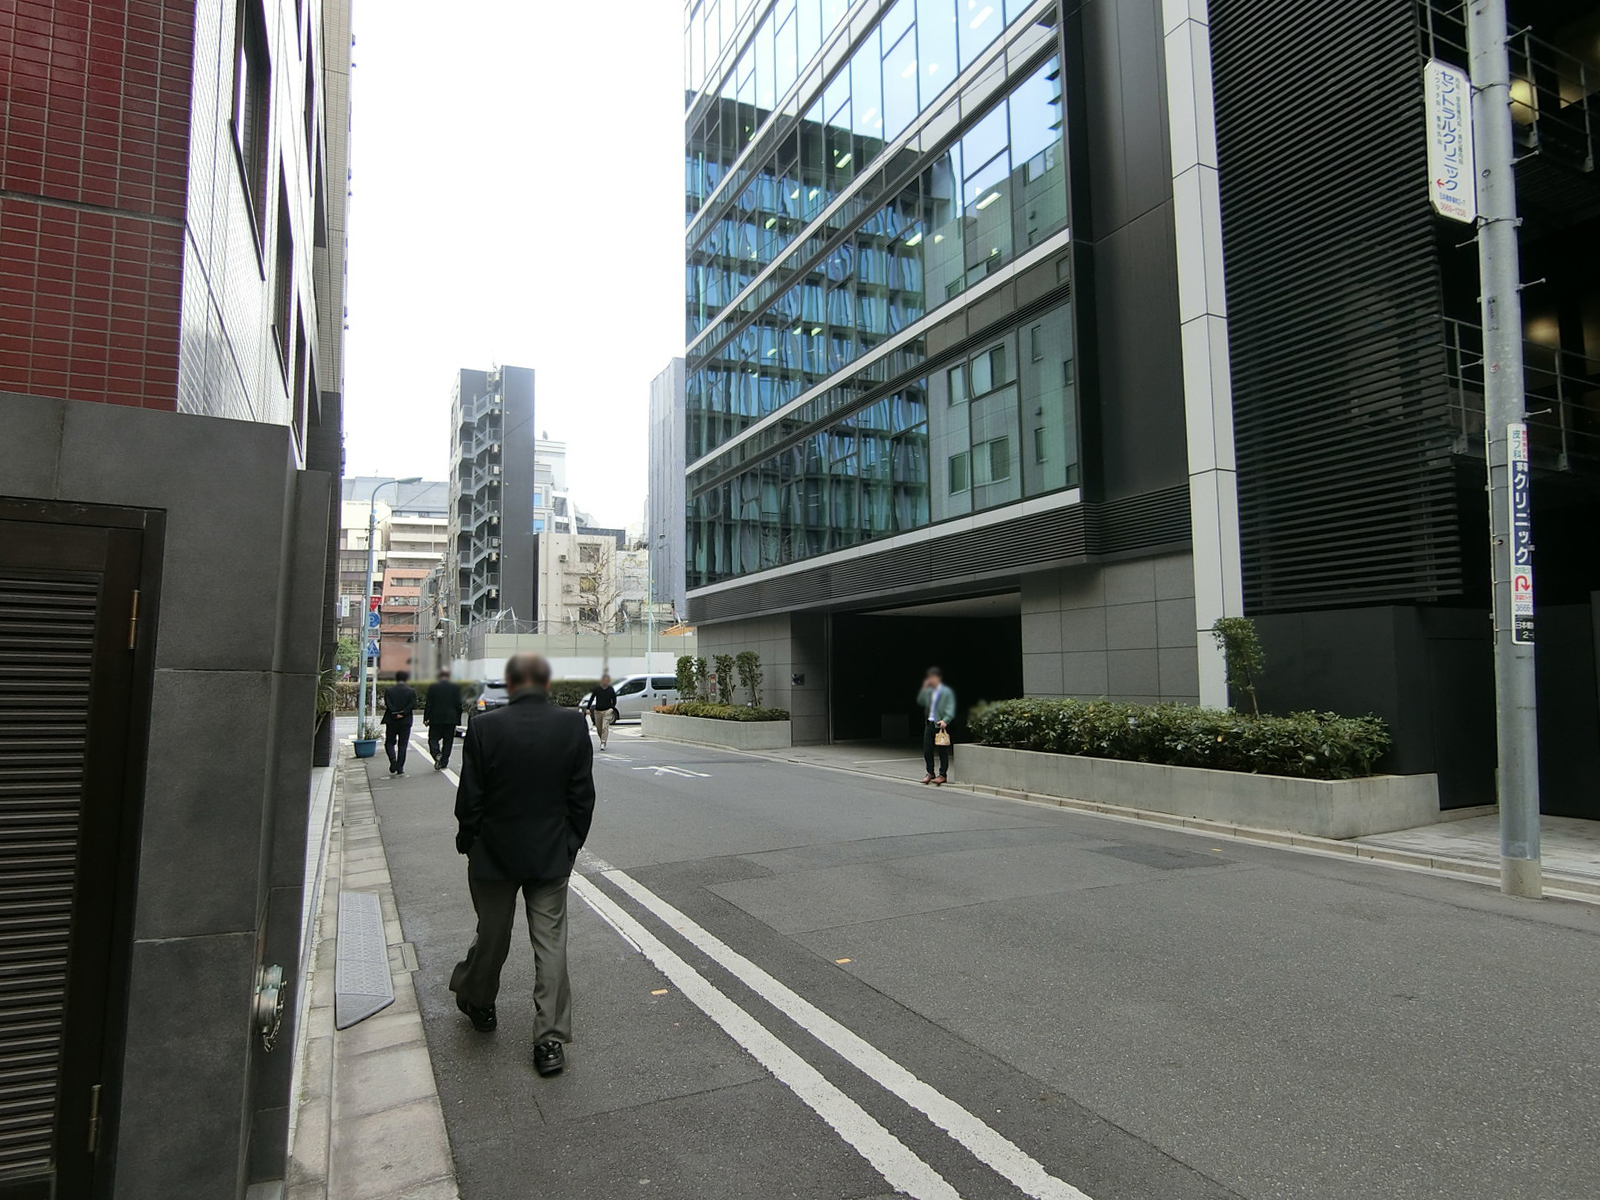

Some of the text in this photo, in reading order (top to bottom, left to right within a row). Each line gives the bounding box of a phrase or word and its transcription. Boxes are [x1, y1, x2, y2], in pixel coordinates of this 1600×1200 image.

[1441, 71, 1458, 191] セントラルクリニック
[1513, 430, 1521, 460] 皮フ科
[1514, 473, 1528, 563] クリニック
